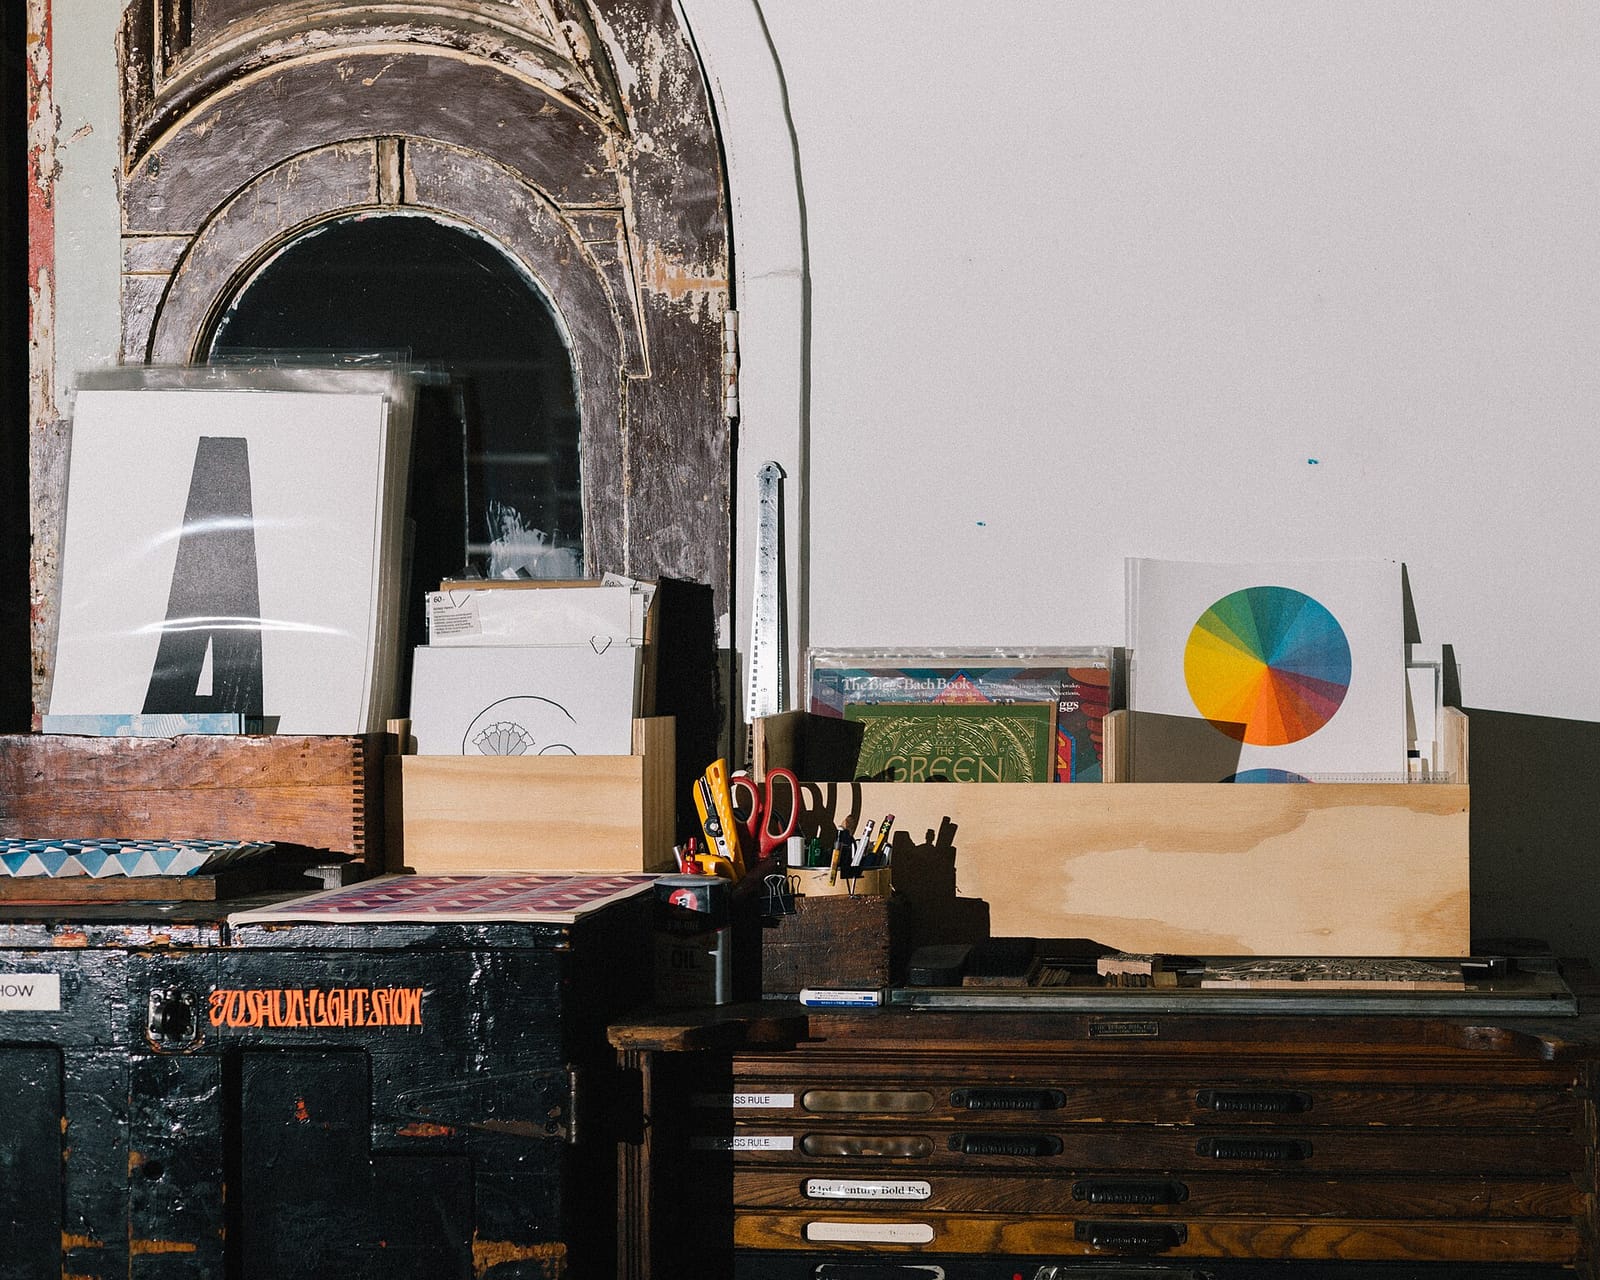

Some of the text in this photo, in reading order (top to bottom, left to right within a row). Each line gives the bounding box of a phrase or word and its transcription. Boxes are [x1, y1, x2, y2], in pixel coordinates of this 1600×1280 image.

[142, 436, 264, 716] A
[842, 677, 867, 691] The
[869, 677, 903, 693] Biggs
[904, 678, 935, 691] Bach
[937, 677, 971, 691] Book
[935, 746, 955, 756] THE
[885, 756, 1004, 783] GREEN
[734, 1096, 770, 1105] SS RULE
[734, 1138, 770, 1147] SS RULE
[881, 1185, 905, 1195] Bold
